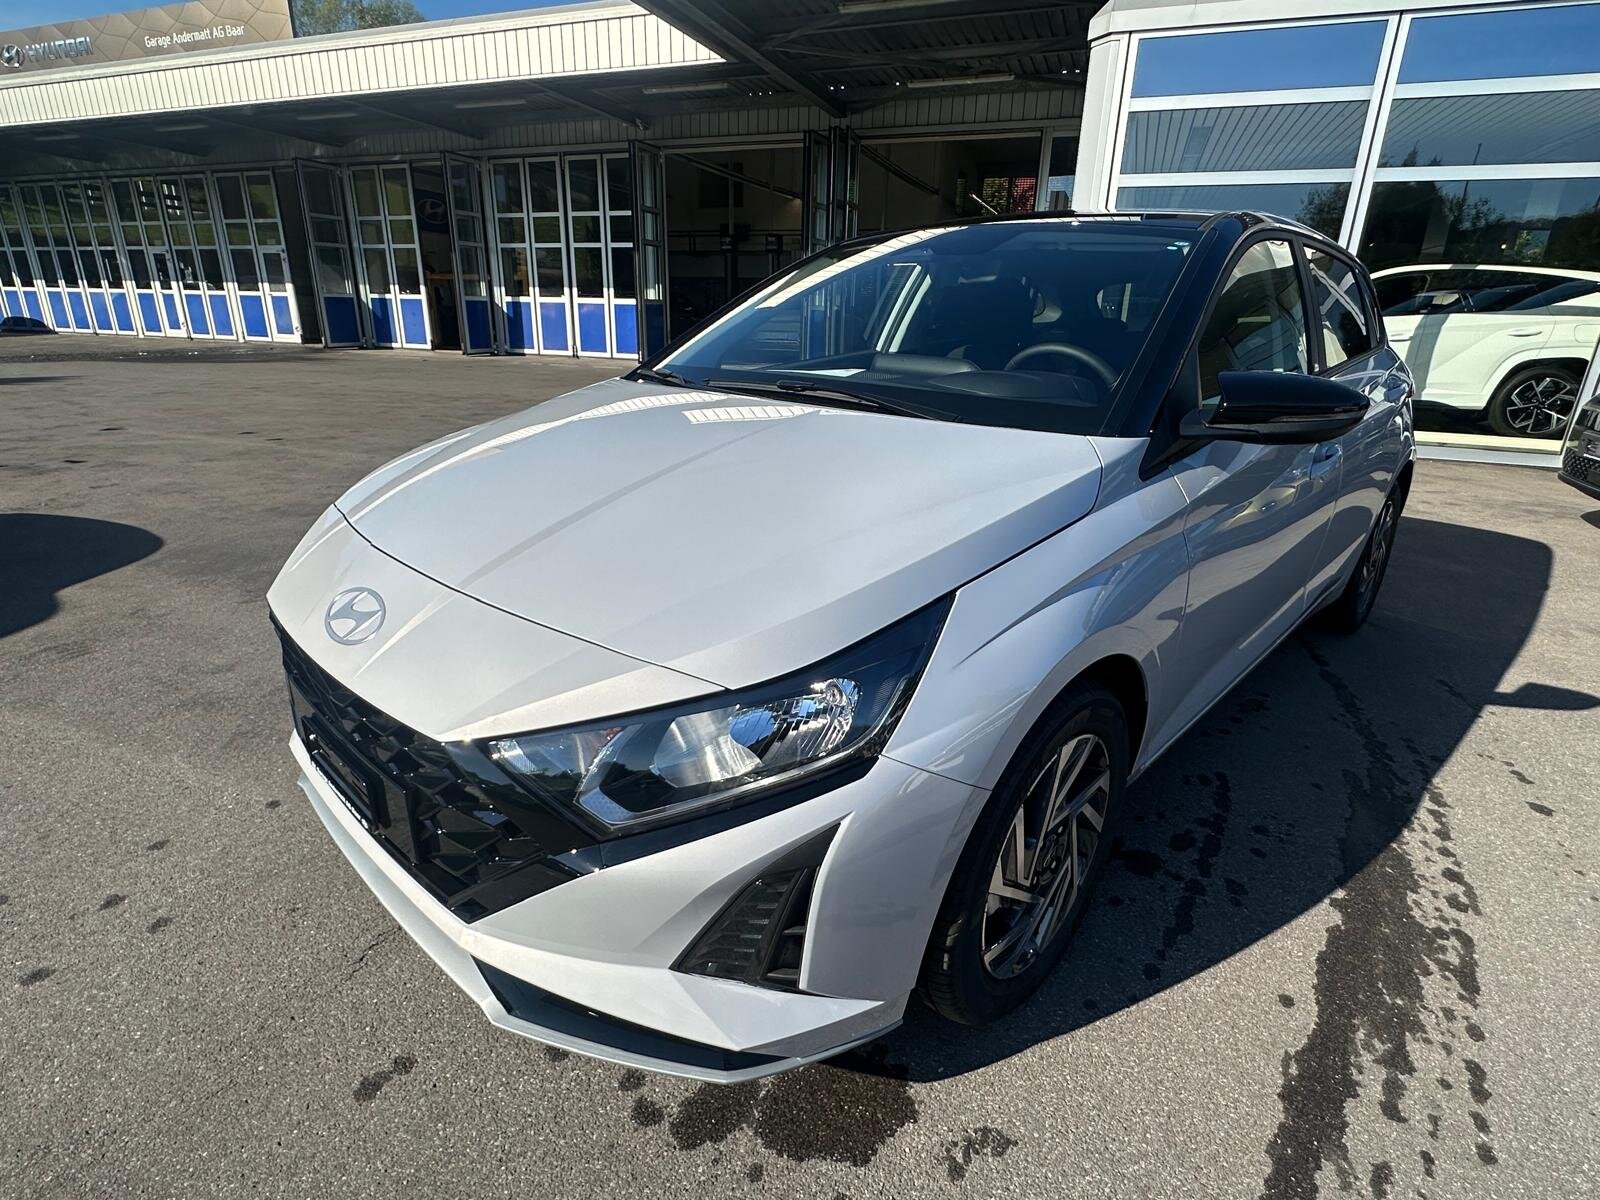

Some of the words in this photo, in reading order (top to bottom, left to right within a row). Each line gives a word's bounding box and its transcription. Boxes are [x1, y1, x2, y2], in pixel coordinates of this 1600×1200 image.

[144, 35, 171, 48] Garage
[172, 28, 212, 44] Andermatt
[212, 26, 225, 39] AG
[225, 25, 245, 37] Baar
